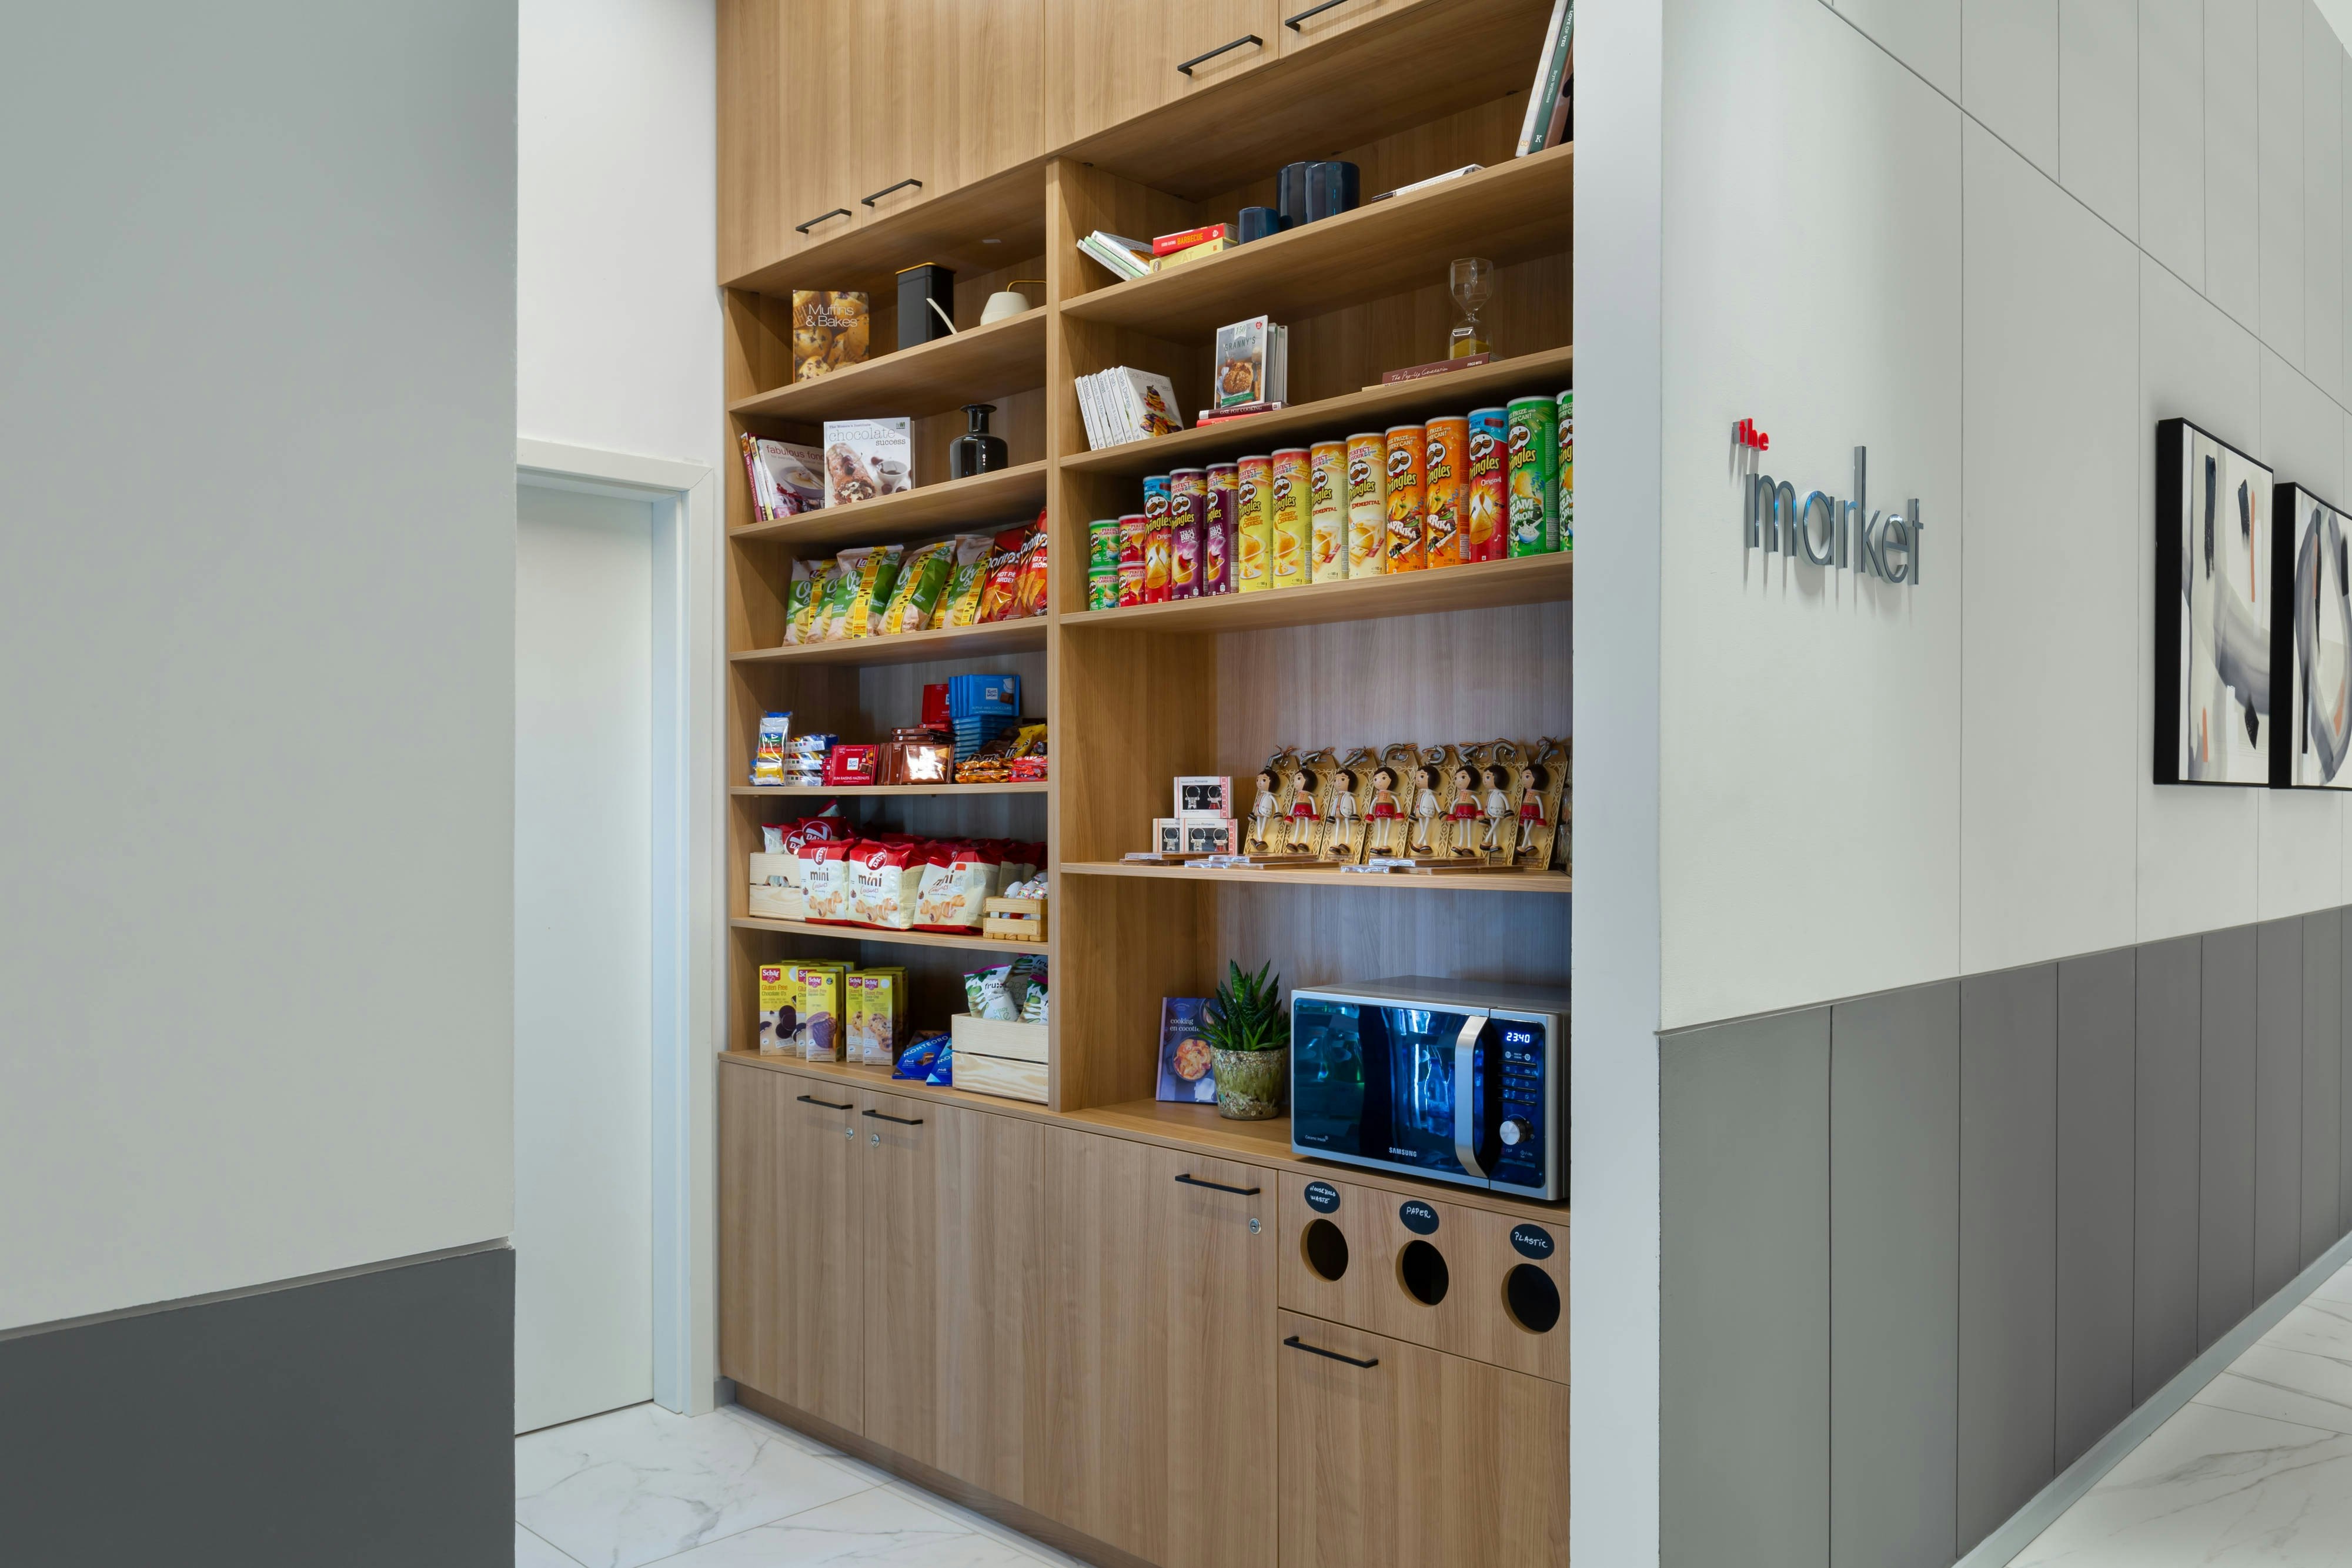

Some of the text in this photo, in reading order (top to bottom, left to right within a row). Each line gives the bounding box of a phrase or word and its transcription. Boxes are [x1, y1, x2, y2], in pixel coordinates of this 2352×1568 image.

[1535, 135, 1542, 143] K
[1177, 232, 1204, 245] BARBECUE
[808, 304, 854, 316] Muffins
[806, 315, 858, 327] & Bakes
[1235, 325, 1246, 335] 150
[1224, 336, 1256, 352] GRANNY'S
[1422, 366, 1448, 375] Generation
[1513, 408, 1528, 417] PRIZE
[1518, 413, 1532, 422] CAN!
[828, 428, 896, 442] chocolate
[1435, 430, 1447, 439] CAN!
[1738, 418, 1769, 452] the
[766, 445, 805, 459] fabulous
[1349, 446, 1371, 457] PERFECT
[1509, 447, 1536, 473] ringles
[1481, 476, 1502, 486] Original
[1351, 500, 1381, 510] EMMENTAL
[1511, 510, 1534, 526] ONION
[1746, 445, 1925, 586] market
[1211, 528, 1222, 537] BBQ
[1387, 521, 1416, 539] PAPRIKA
[873, 854, 886, 868] DAYS
[810, 867, 829, 881] mini
[858, 872, 883, 887] mini
[903, 1035, 948, 1058] MONTEORO
[1389, 1147, 1417, 1158] SAMSUNG
[1309, 1185, 1336, 1197] HOUSEHOLD
[1310, 1195, 1331, 1204] WASTE
[1406, 1206, 1431, 1219] PAPER
